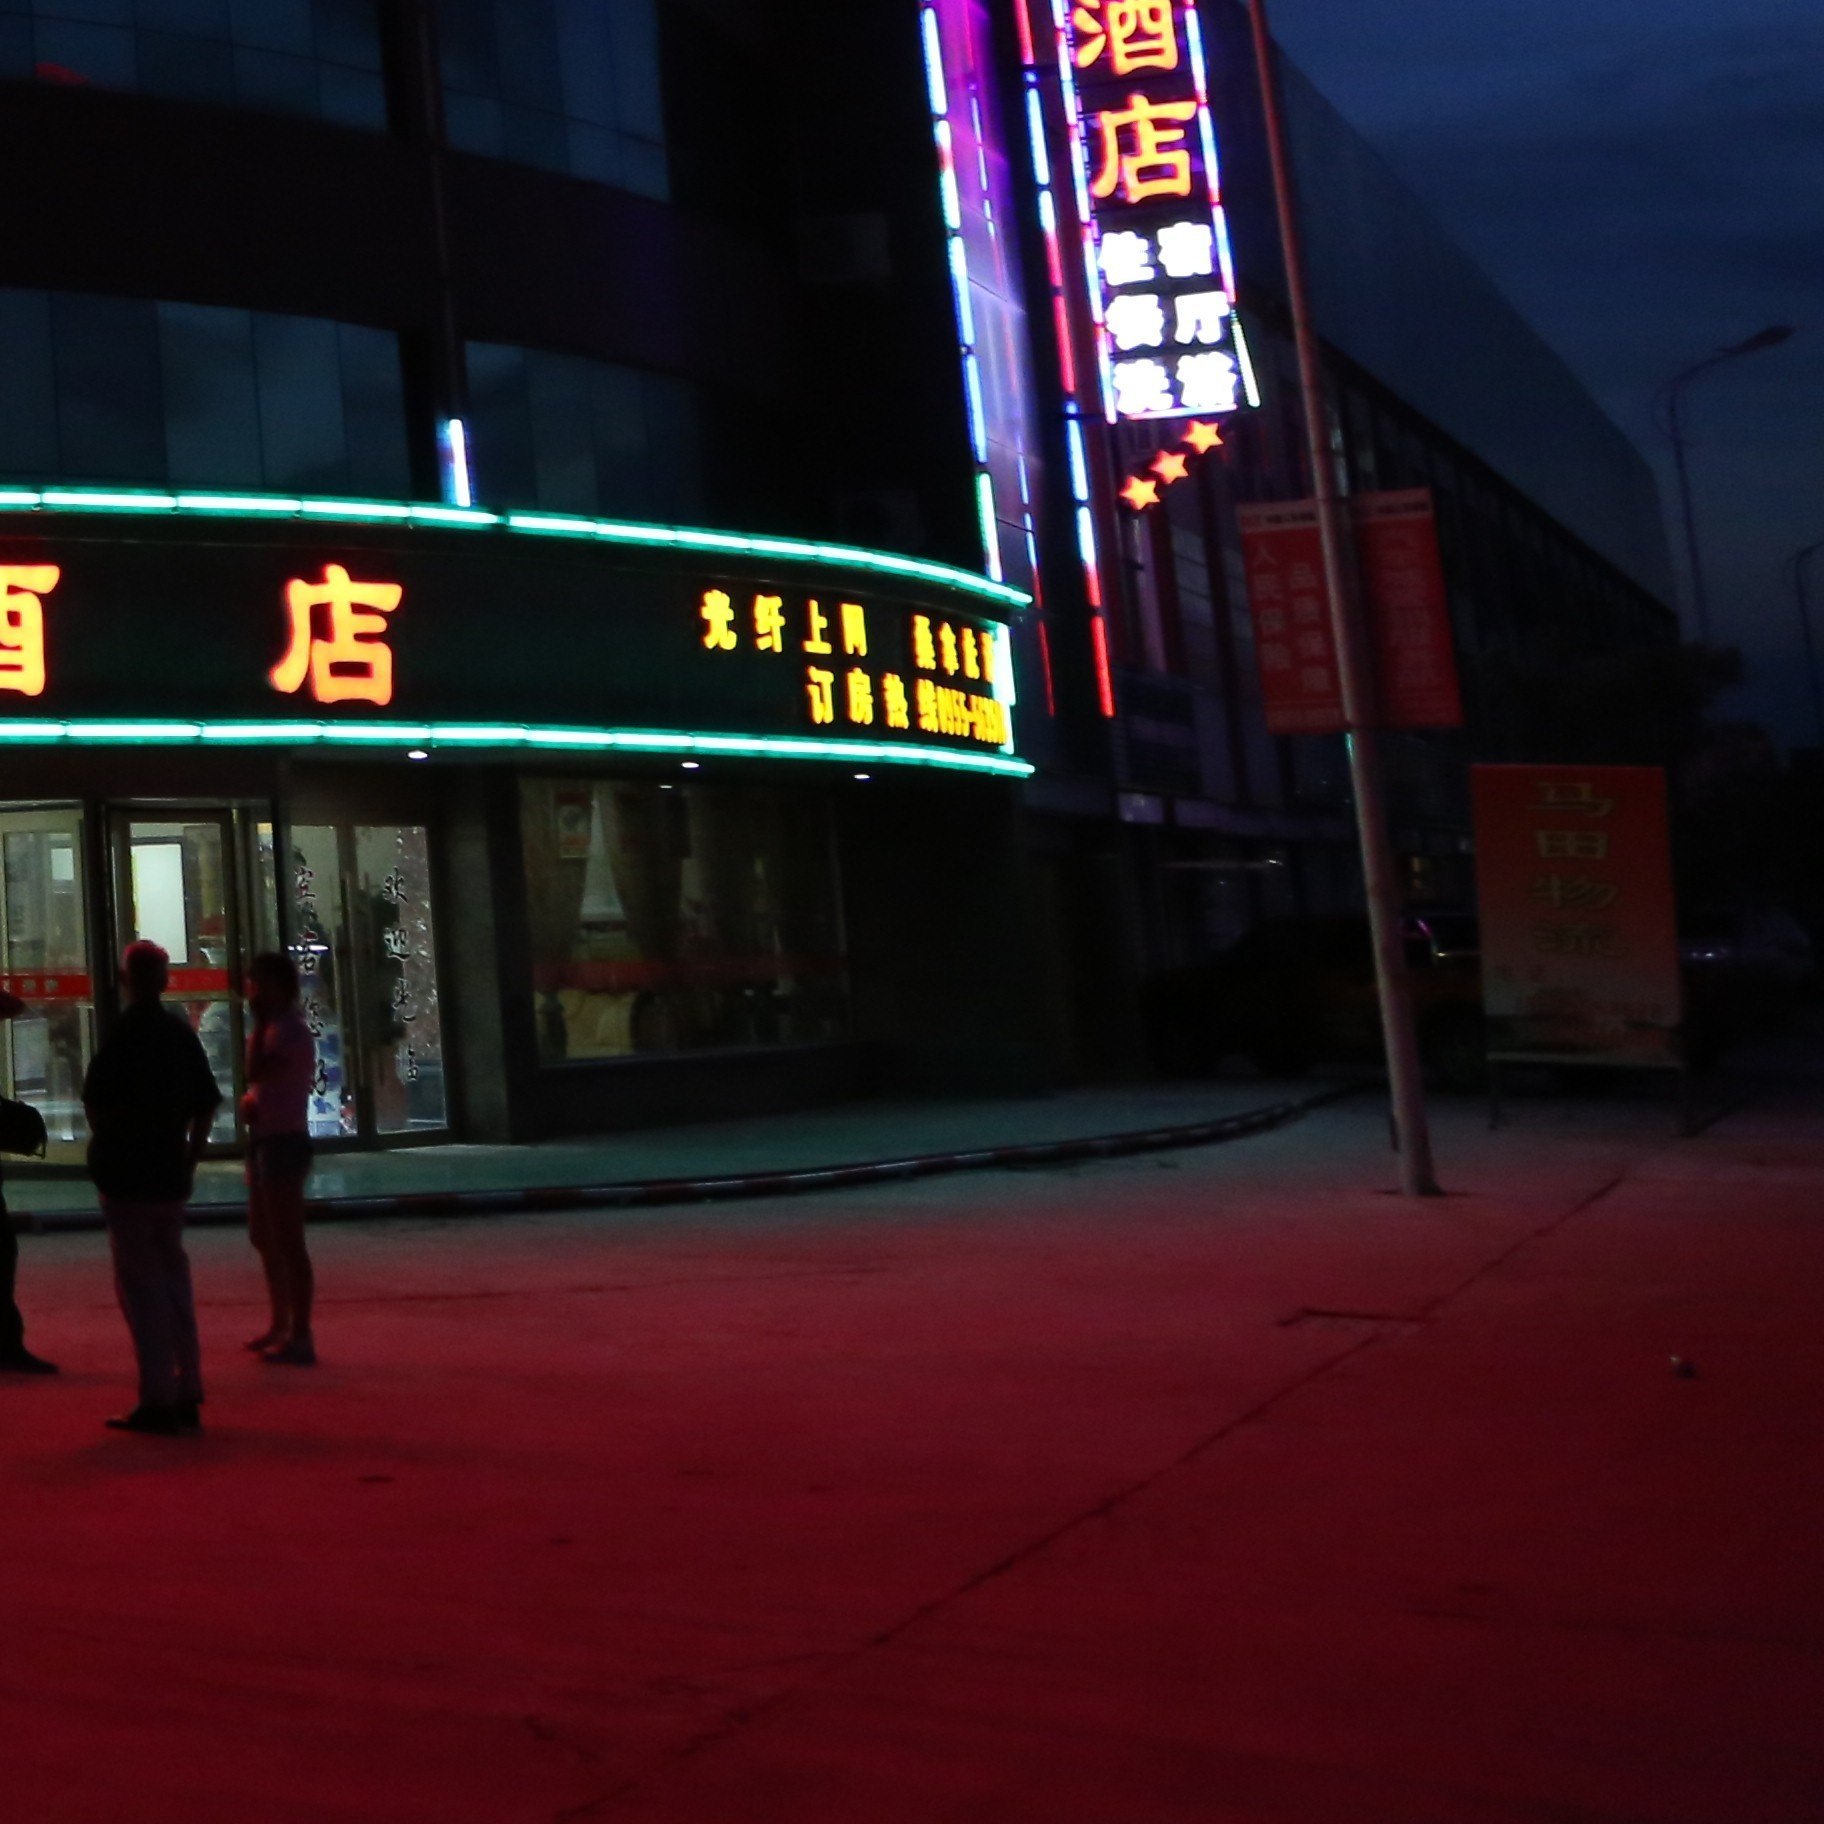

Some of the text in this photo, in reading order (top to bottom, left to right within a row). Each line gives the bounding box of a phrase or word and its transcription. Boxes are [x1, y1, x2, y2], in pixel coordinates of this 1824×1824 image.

[700, 588, 868, 657] 光纤上网
[1526, 781, 1629, 959] 马田物流
